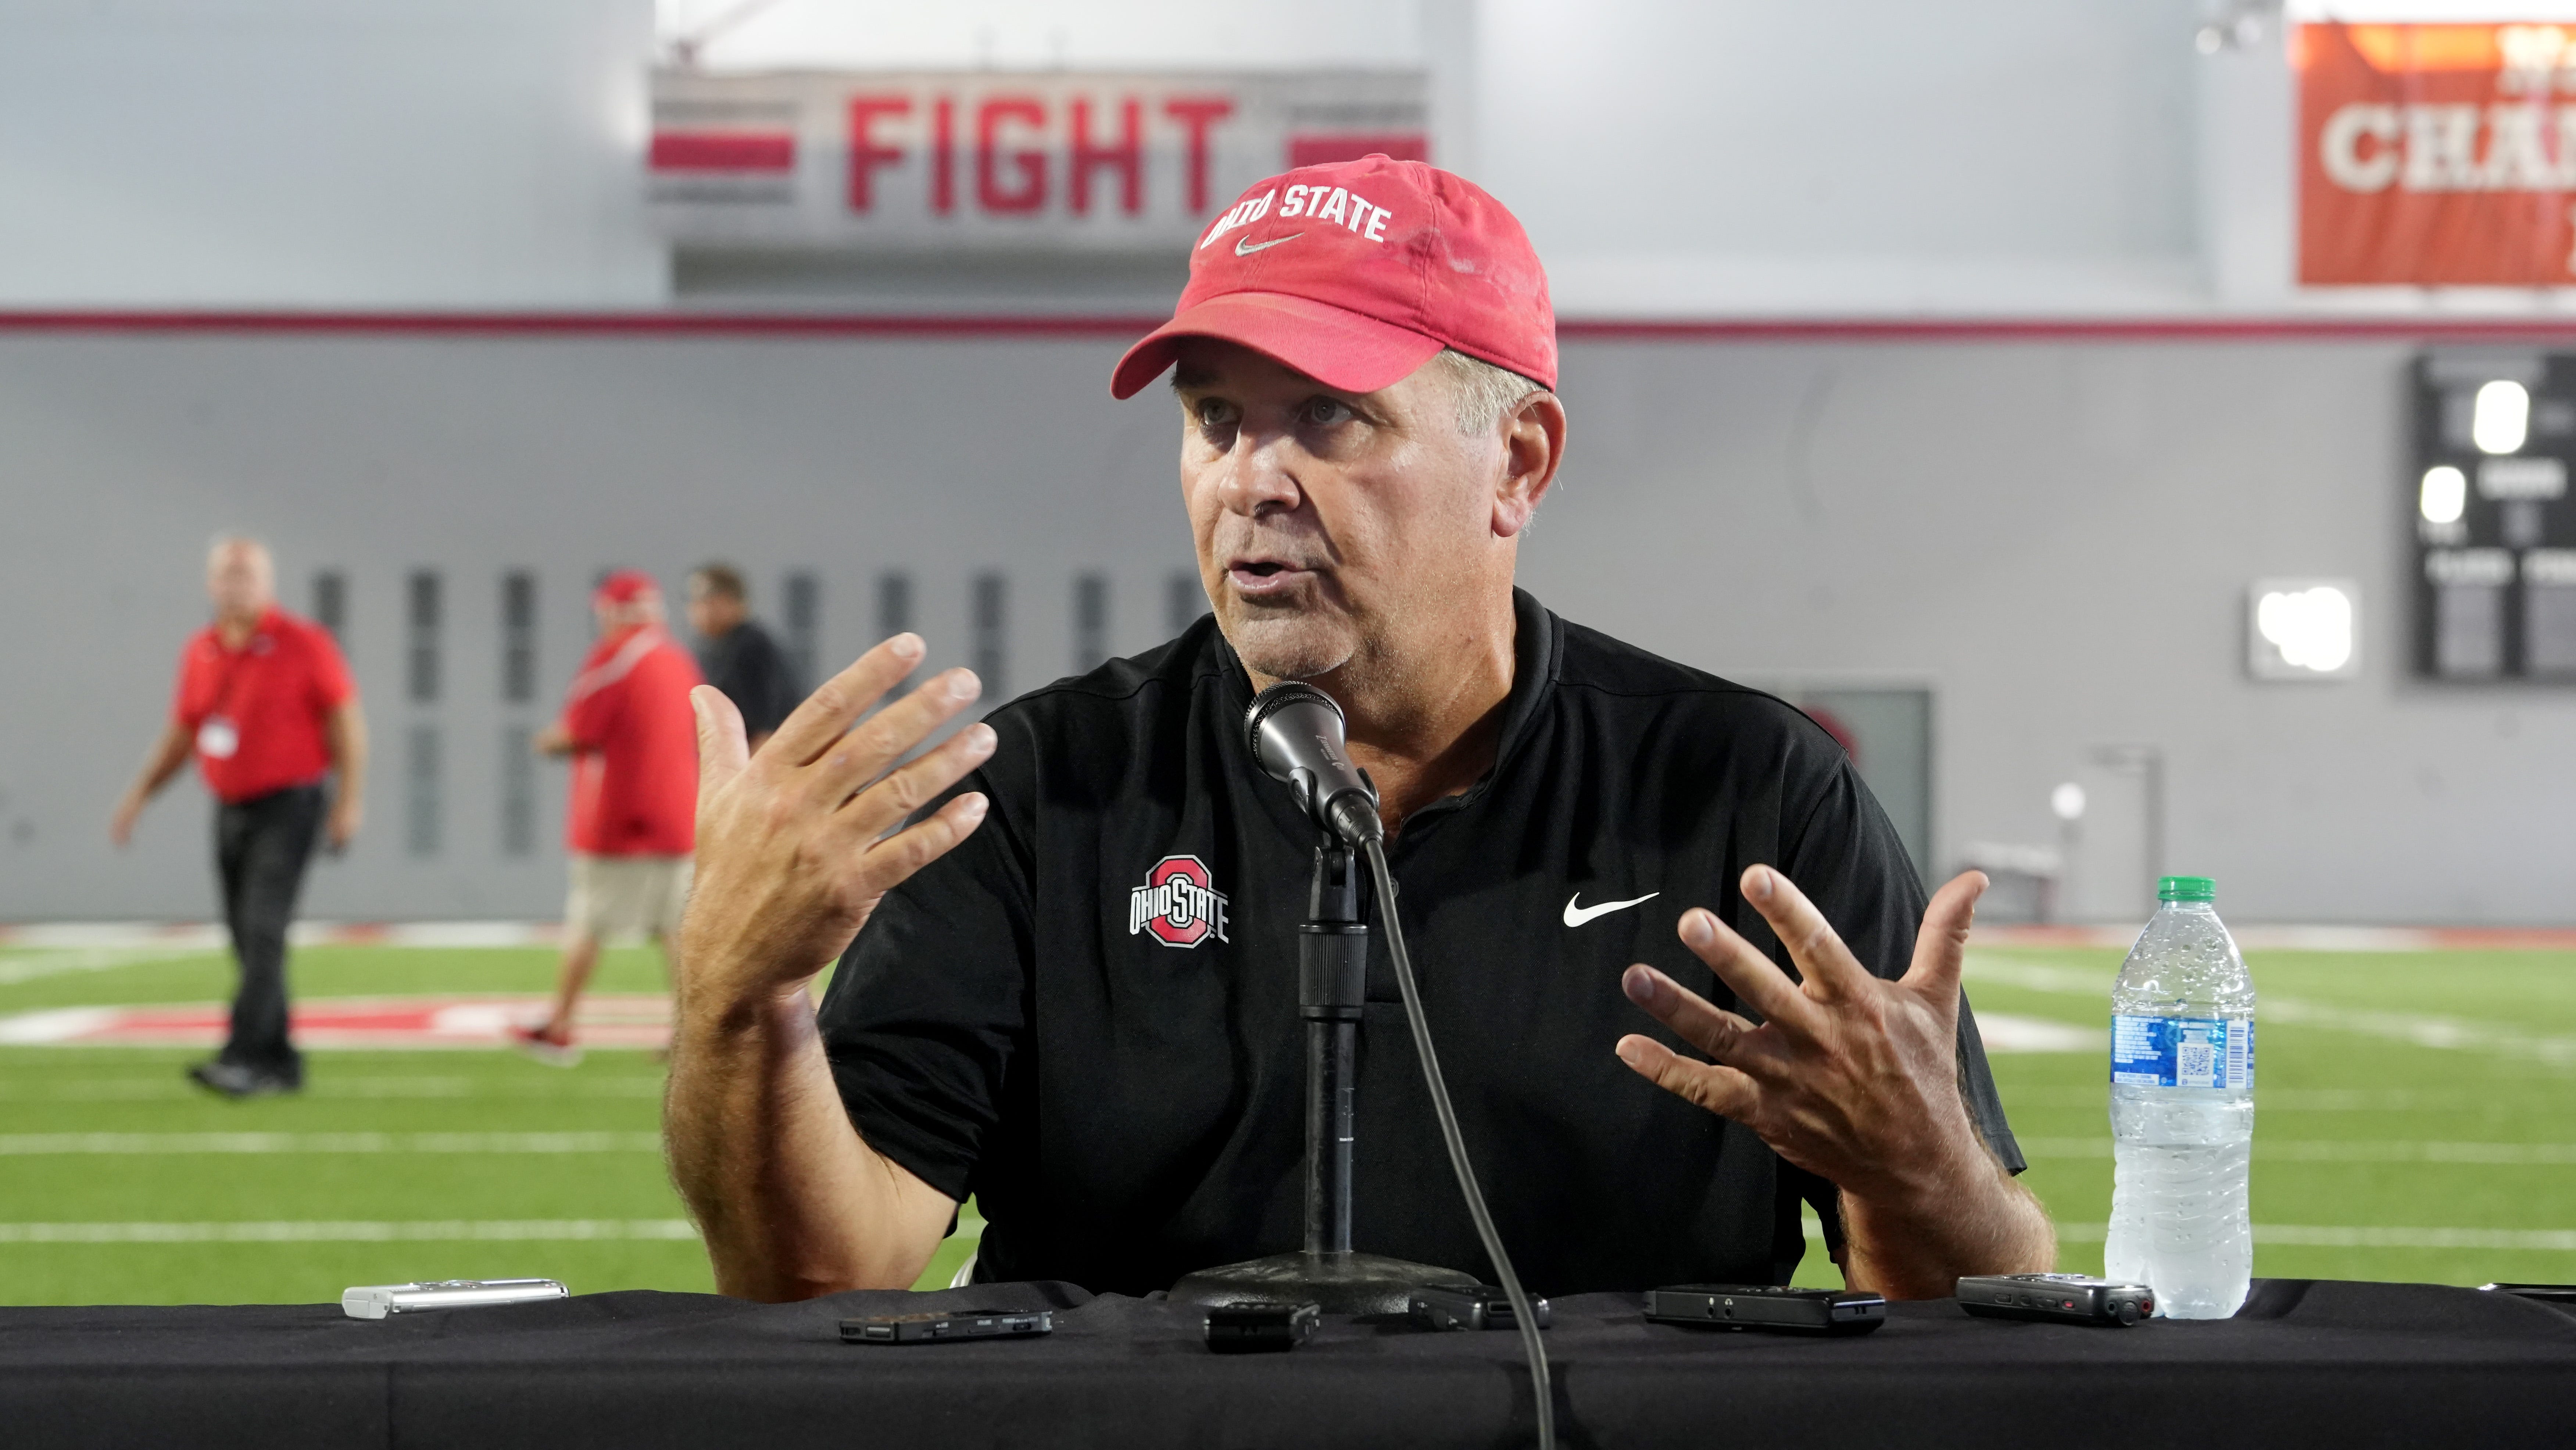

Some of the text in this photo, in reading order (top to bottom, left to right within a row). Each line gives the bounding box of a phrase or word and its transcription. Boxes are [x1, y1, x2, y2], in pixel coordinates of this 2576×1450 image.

[846, 98, 1236, 213] FIGHT
[1200, 184, 1392, 250] OHIO STATE
